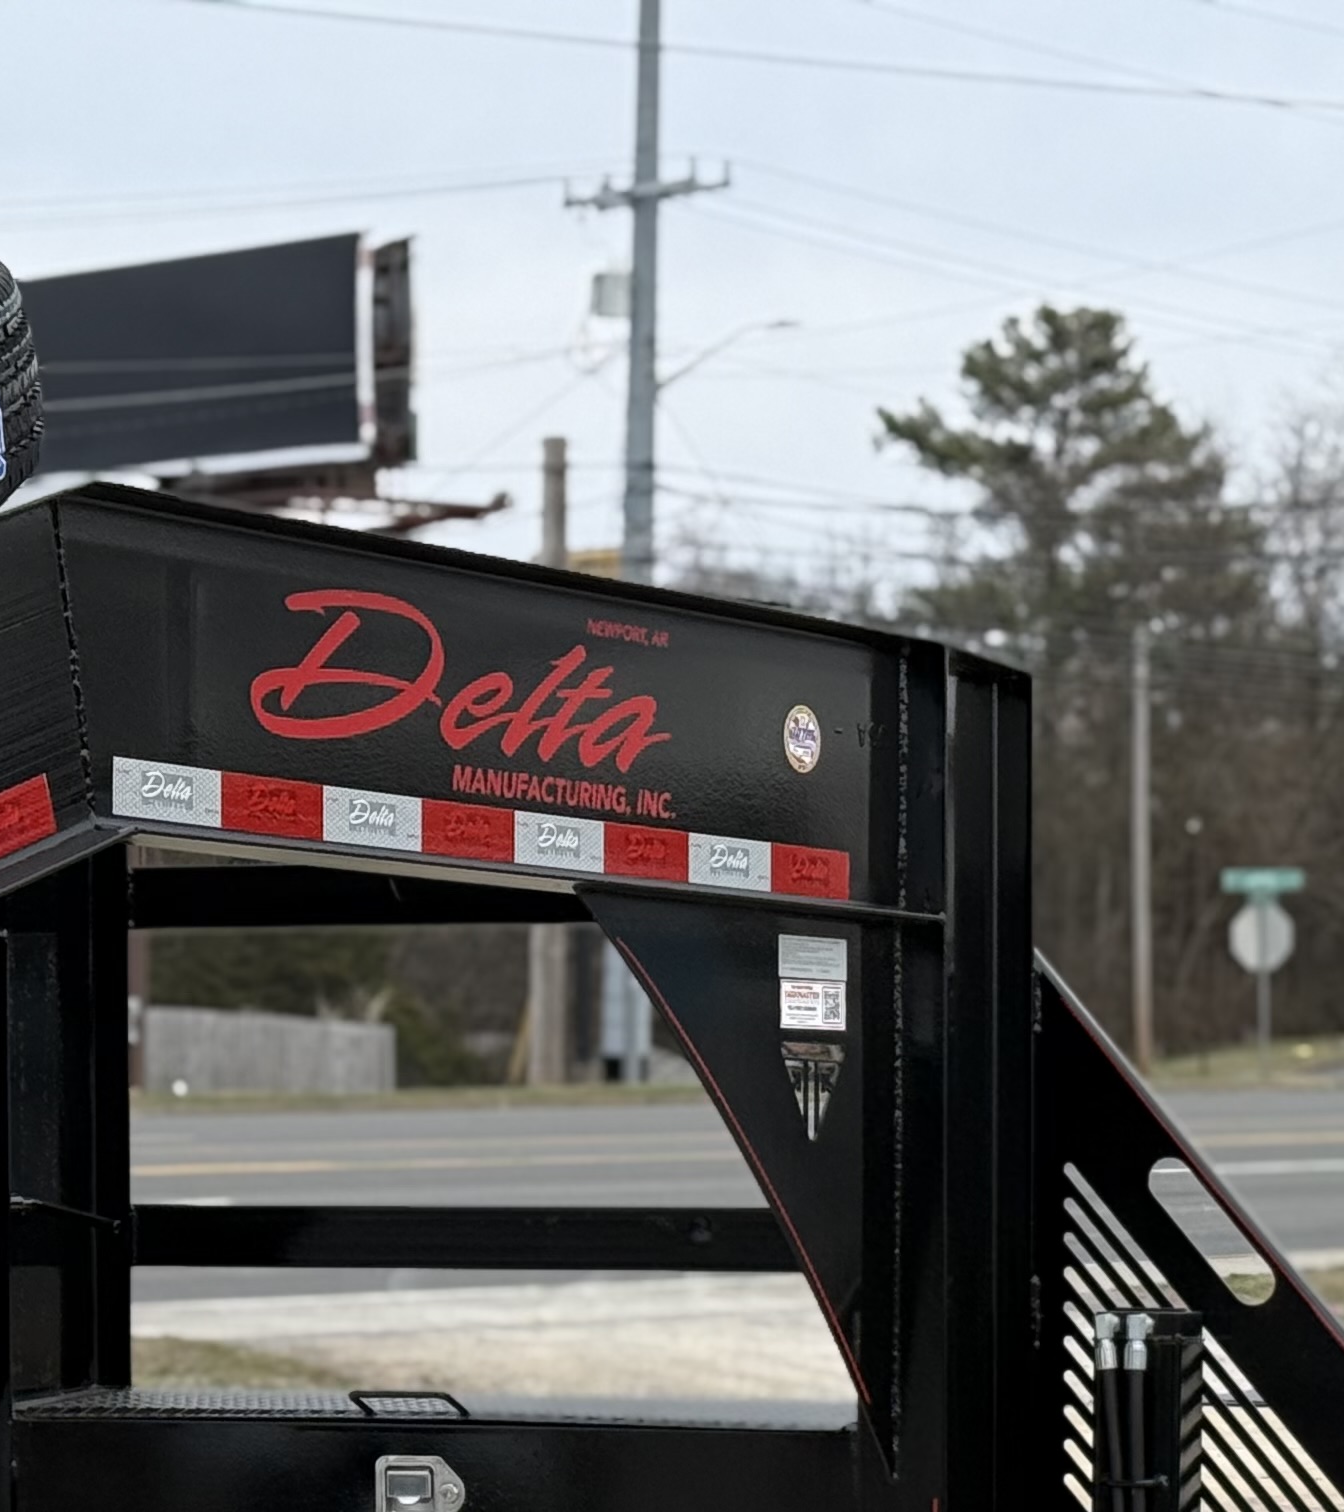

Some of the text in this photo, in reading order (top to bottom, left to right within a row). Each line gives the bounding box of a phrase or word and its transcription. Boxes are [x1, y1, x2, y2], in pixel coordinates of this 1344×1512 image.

[587, 618, 670, 648] NEWPORT, AR
[250, 588, 672, 773] Delta
[141, 770, 193, 801] Delta
[451, 764, 676, 820] MANUFACTURING, INC.
[349, 799, 395, 828] Delta
